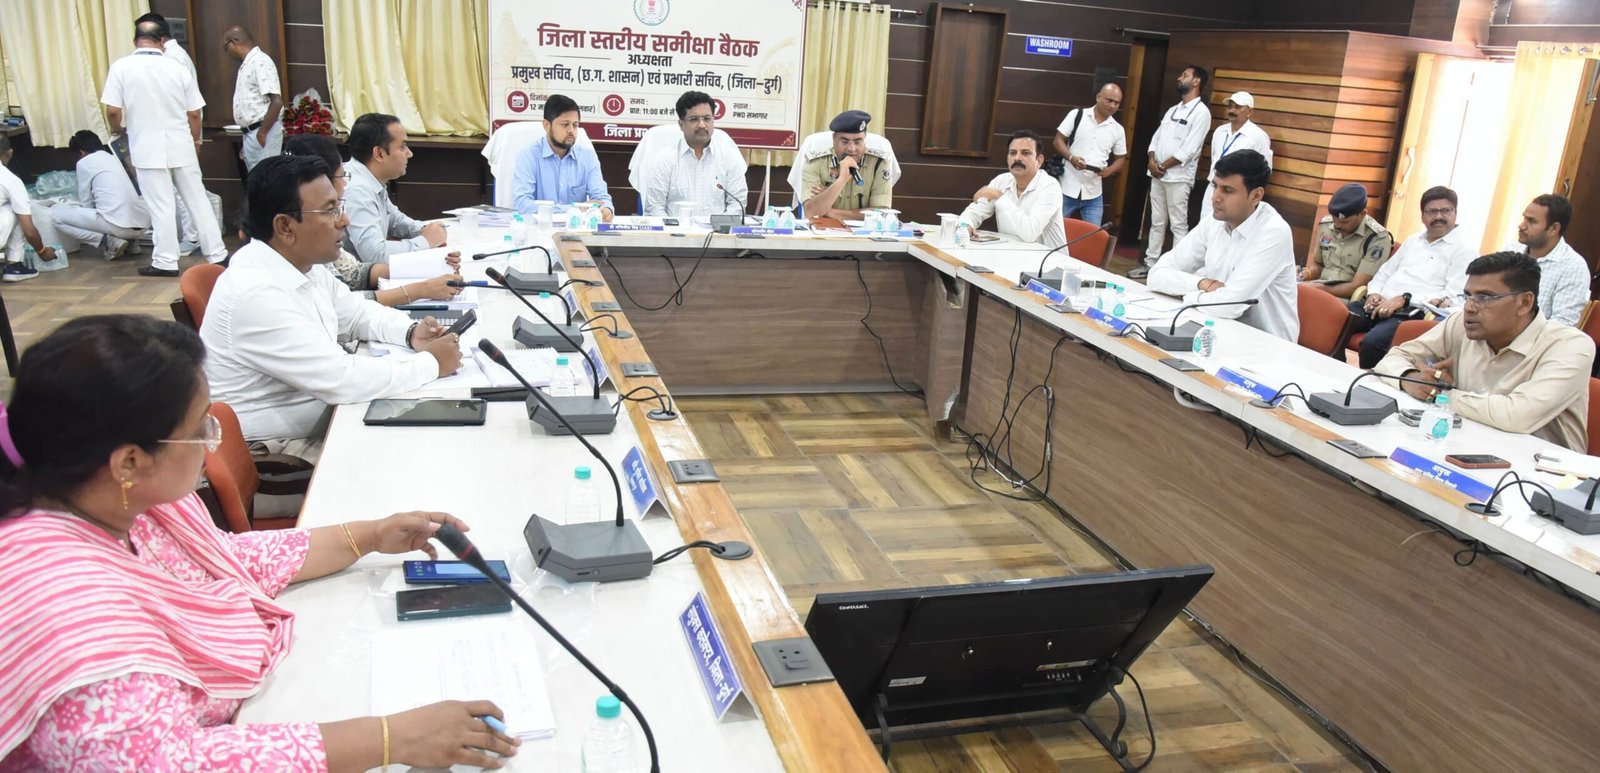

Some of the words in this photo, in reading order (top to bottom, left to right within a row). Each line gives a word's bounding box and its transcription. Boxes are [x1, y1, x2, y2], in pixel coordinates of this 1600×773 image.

[537, 22, 586, 48] जिला
[589, 27, 648, 51] स्तरीय
[651, 30, 716, 55] समीक्षा
[718, 33, 760, 57] बैठक
[1029, 38, 1070, 49] WASHROOM
[627, 53, 673, 67] अध्यक्षता
[511, 66, 541, 83] प्रमुख
[543, 64, 574, 83] सचिव,
[577, 66, 605, 84] (छ.ग.
[608, 70, 645, 87] शासन)
[647, 69, 661, 84] एवं
[663, 70, 693, 86] प्रभारी
[695, 71, 724, 90] सचिव,
[530, 103, 537, 111] 12
[642, 107, 658, 115] 11:00
[603, 124, 633, 138] जिला
